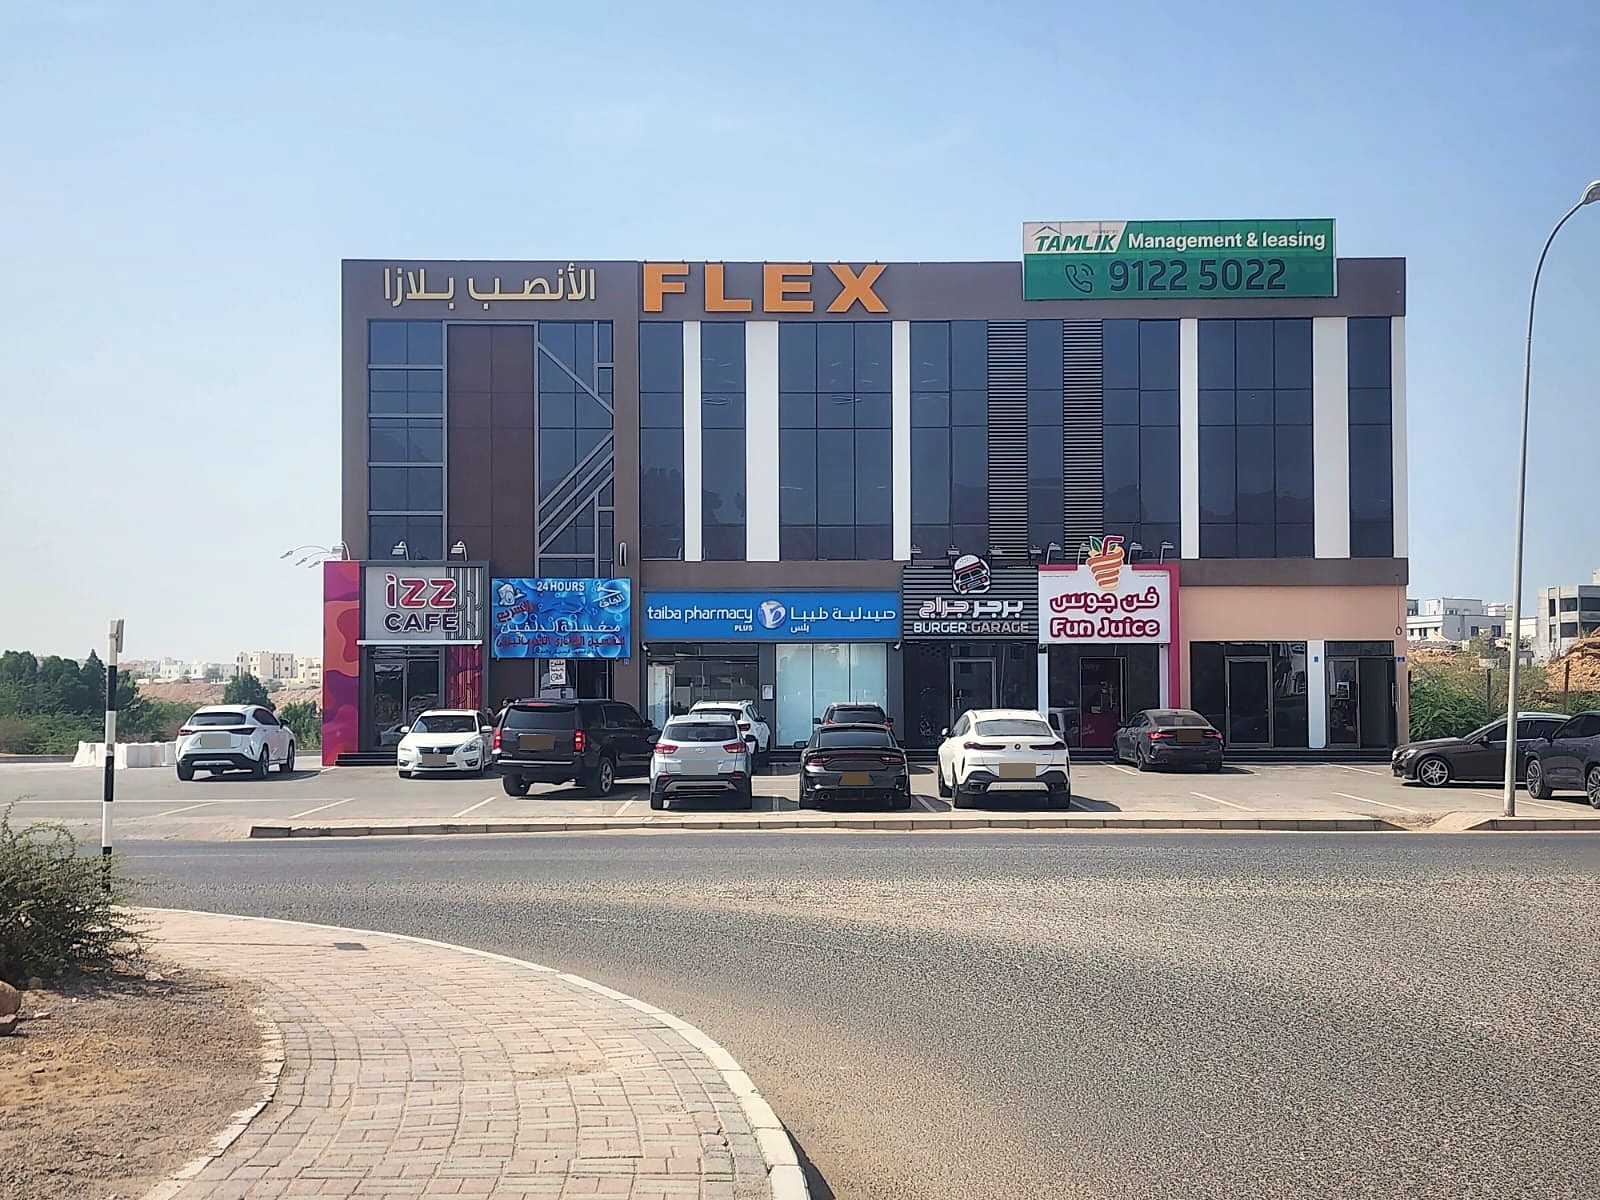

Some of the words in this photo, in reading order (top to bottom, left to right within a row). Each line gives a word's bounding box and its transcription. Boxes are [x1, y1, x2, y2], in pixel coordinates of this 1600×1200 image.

[1033, 234, 1118, 252] TAMLIK
[1128, 232, 1242, 252] Management
[1243, 233, 1258, 248] &
[1262, 232, 1326, 250] leasing
[1109, 259, 1188, 292] 9122
[1199, 258, 1286, 291] 5022
[384, 267, 456, 310] بلازا
[467, 262, 596, 310] الأنصب
[643, 263, 889, 313] FLEX
[536, 581, 549, 592] 24
[550, 581, 585, 592] HOURS
[919, 596, 970, 619] جراج
[972, 600, 1024, 619] برجر
[1050, 591, 1118, 614] جوس
[1120, 586, 1159, 613] فن
[384, 612, 459, 633] CAFE
[647, 606, 681, 620] taiba
[684, 606, 753, 623] pharmacy
[790, 606, 829, 623] طيبا
[832, 606, 896, 623] صيدلية
[560, 620, 621, 633] مغسلة
[790, 623, 810, 634] بلس
[913, 622, 967, 633] BURGER
[971, 622, 1029, 633] GARAGE
[1050, 617, 1094, 637] Fun
[1097, 616, 1160, 637] Juice
